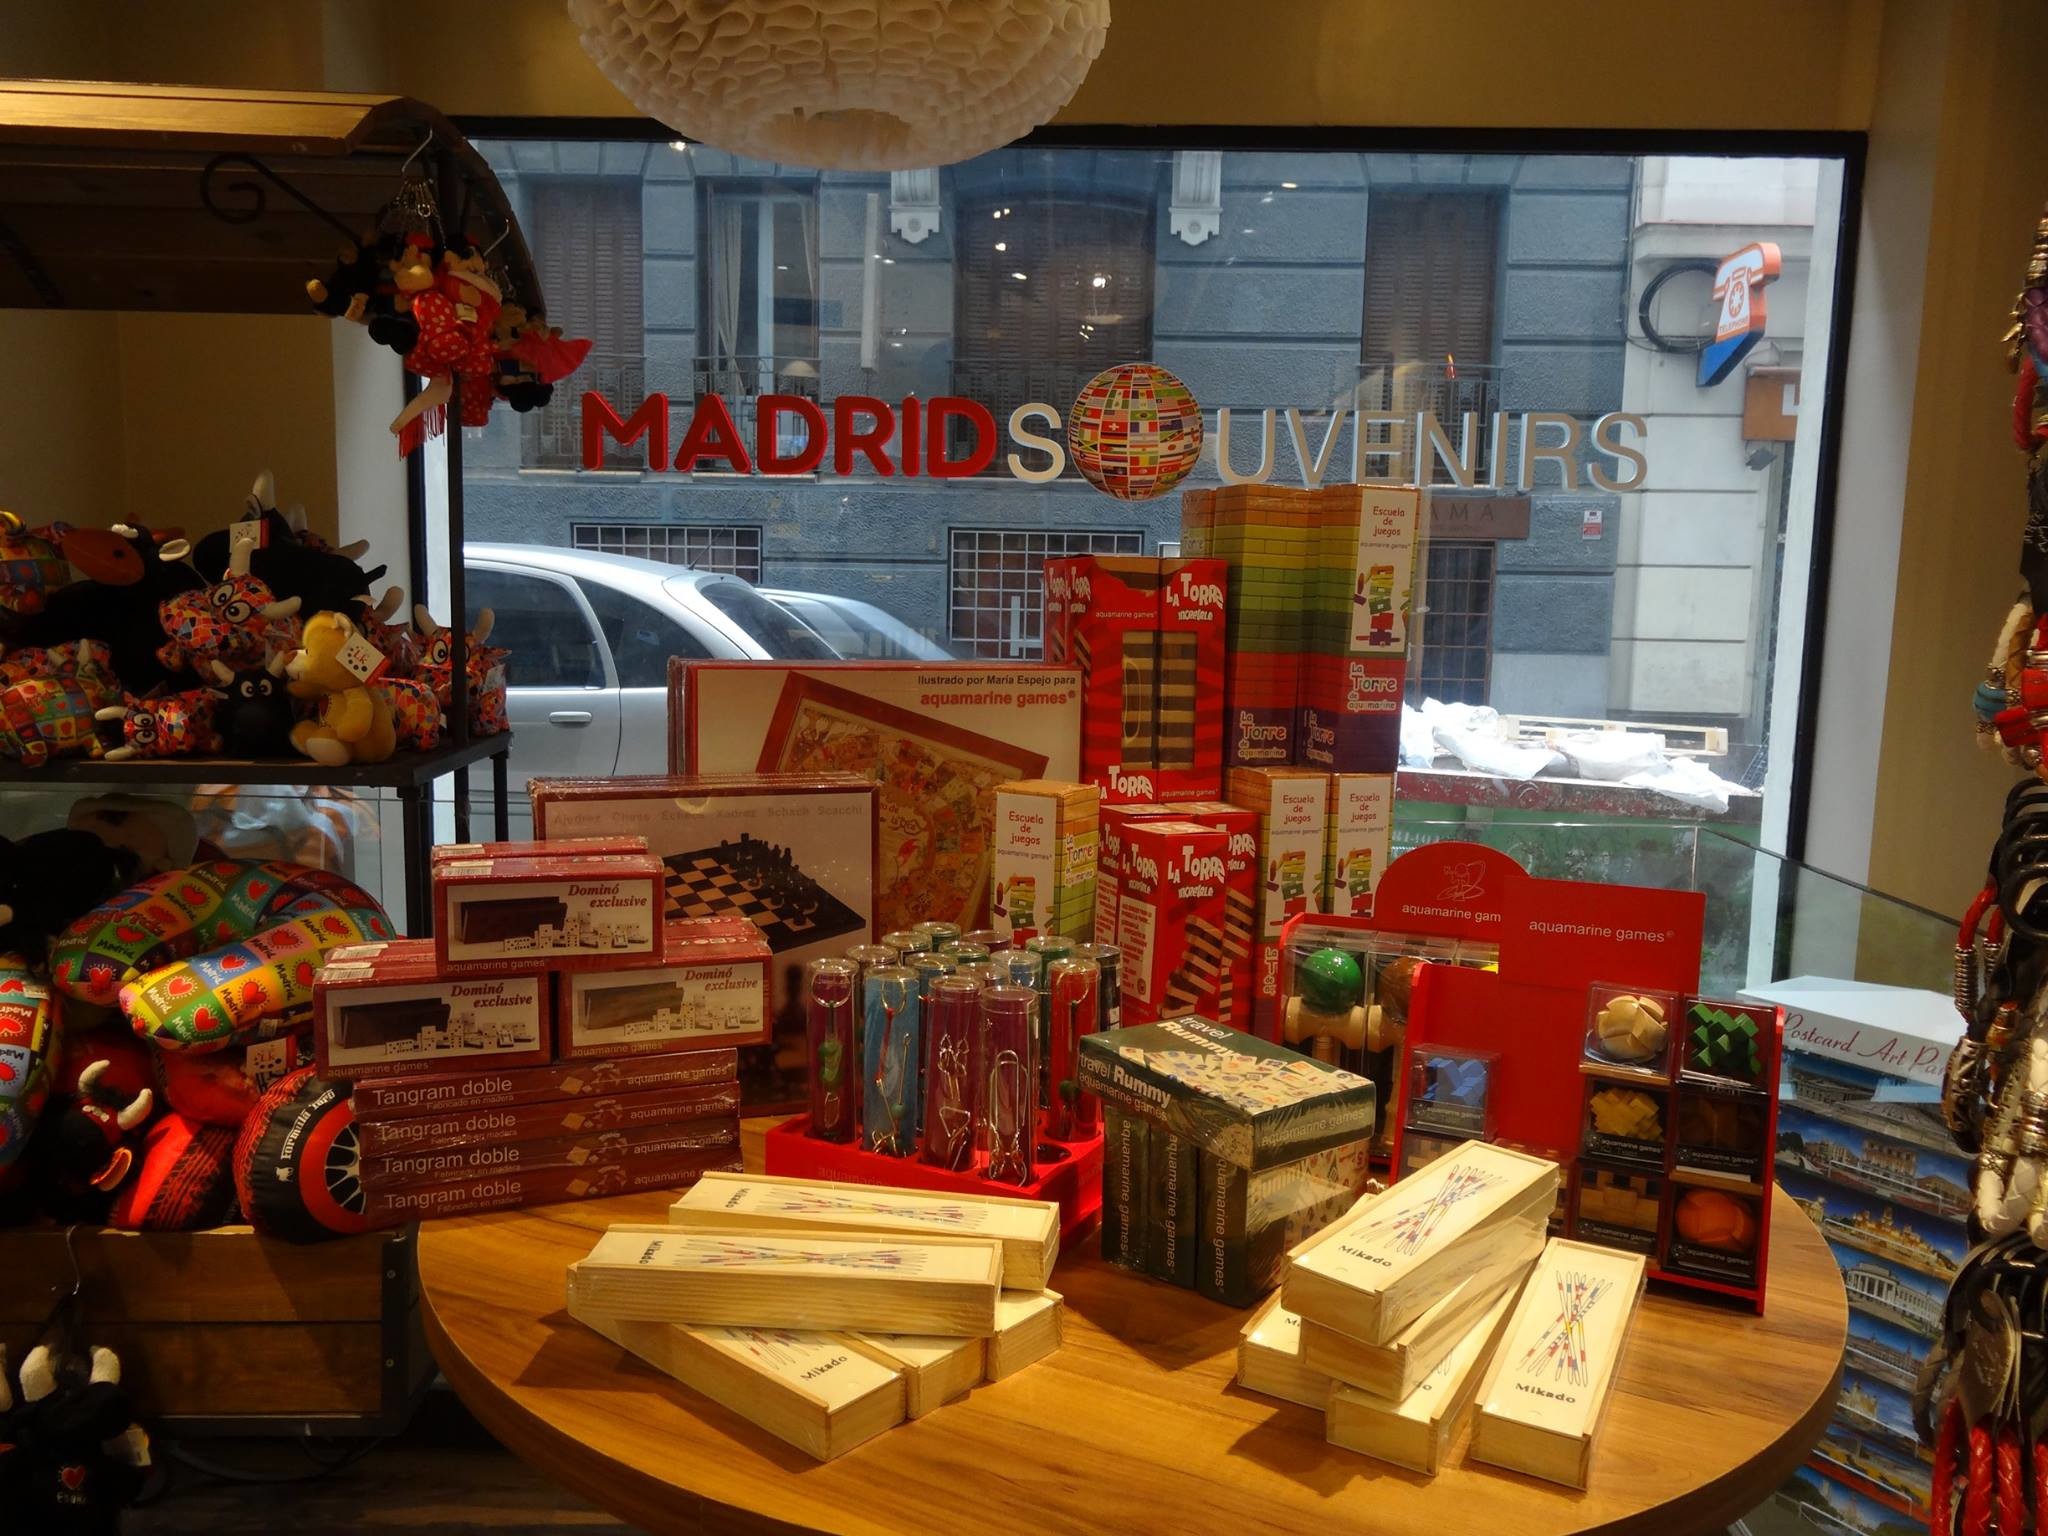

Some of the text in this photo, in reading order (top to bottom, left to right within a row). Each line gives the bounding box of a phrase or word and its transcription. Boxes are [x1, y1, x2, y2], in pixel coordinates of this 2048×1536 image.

[581, 390, 997, 477] MADRID
[1373, 505, 1405, 517] Escuela
[1383, 517, 1393, 526] de
[1373, 526, 1401, 537] juegos
[1351, 662, 1363, 673] La
[918, 675, 964, 685] Ilustrado
[966, 677, 984, 687] por
[1017, 675, 1051, 687] Espejo
[1054, 677, 1076, 687] para
[1350, 675, 1397, 692] Torre
[920, 691, 1012, 708] aquamarine
[1348, 700, 1396, 712] aquamarine
[1240, 711, 1254, 723] La
[1240, 724, 1287, 740] Torre
[1282, 795, 1314, 804] Escuela
[1350, 793, 1380, 803] Escuela
[1293, 804, 1303, 813] de
[1359, 803, 1370, 812] de
[1009, 811, 1044, 825] Escuela
[1284, 814, 1311, 825] juegos
[1351, 813, 1377, 823] juegos
[1020, 824, 1032, 834] de
[1009, 833, 1041, 847] juegos
[568, 883, 620, 897] Dominó
[589, 896, 648, 908] exclusive
[1402, 904, 1501, 923] aquamarine gam
[302, 918, 328, 944] Madrid
[1529, 920, 1612, 938] aquamarine
[447, 959, 544, 973] aquamarine games
[684, 966, 733, 981] Dominó
[274, 963, 296, 1001] Madrid
[705, 979, 759, 992] exclusive
[451, 982, 504, 998] Dominó
[473, 995, 533, 1009] exclusive
[1179, 1016, 1234, 1040] travel
[1783, 1011, 1860, 1053] Postcard
[1857, 1036, 1908, 1067] Art
[1079, 1052, 1172, 1109] travel Rummy
[372, 1077, 513, 1106] Tangram doble
[377, 1113, 517, 1141] Tangram doble
[381, 1147, 520, 1175] Tangram doble
[1121, 1119, 1131, 1201] aquamarine
[384, 1180, 521, 1209] Tangram doble
[1165, 1135, 1178, 1268] aquamarine games
[1212, 1158, 1228, 1288] quamarine games
[1338, 1244, 1392, 1267] Mikado
[800, 1356, 848, 1380] Mikado
[1514, 1382, 1576, 1405] Mikado
